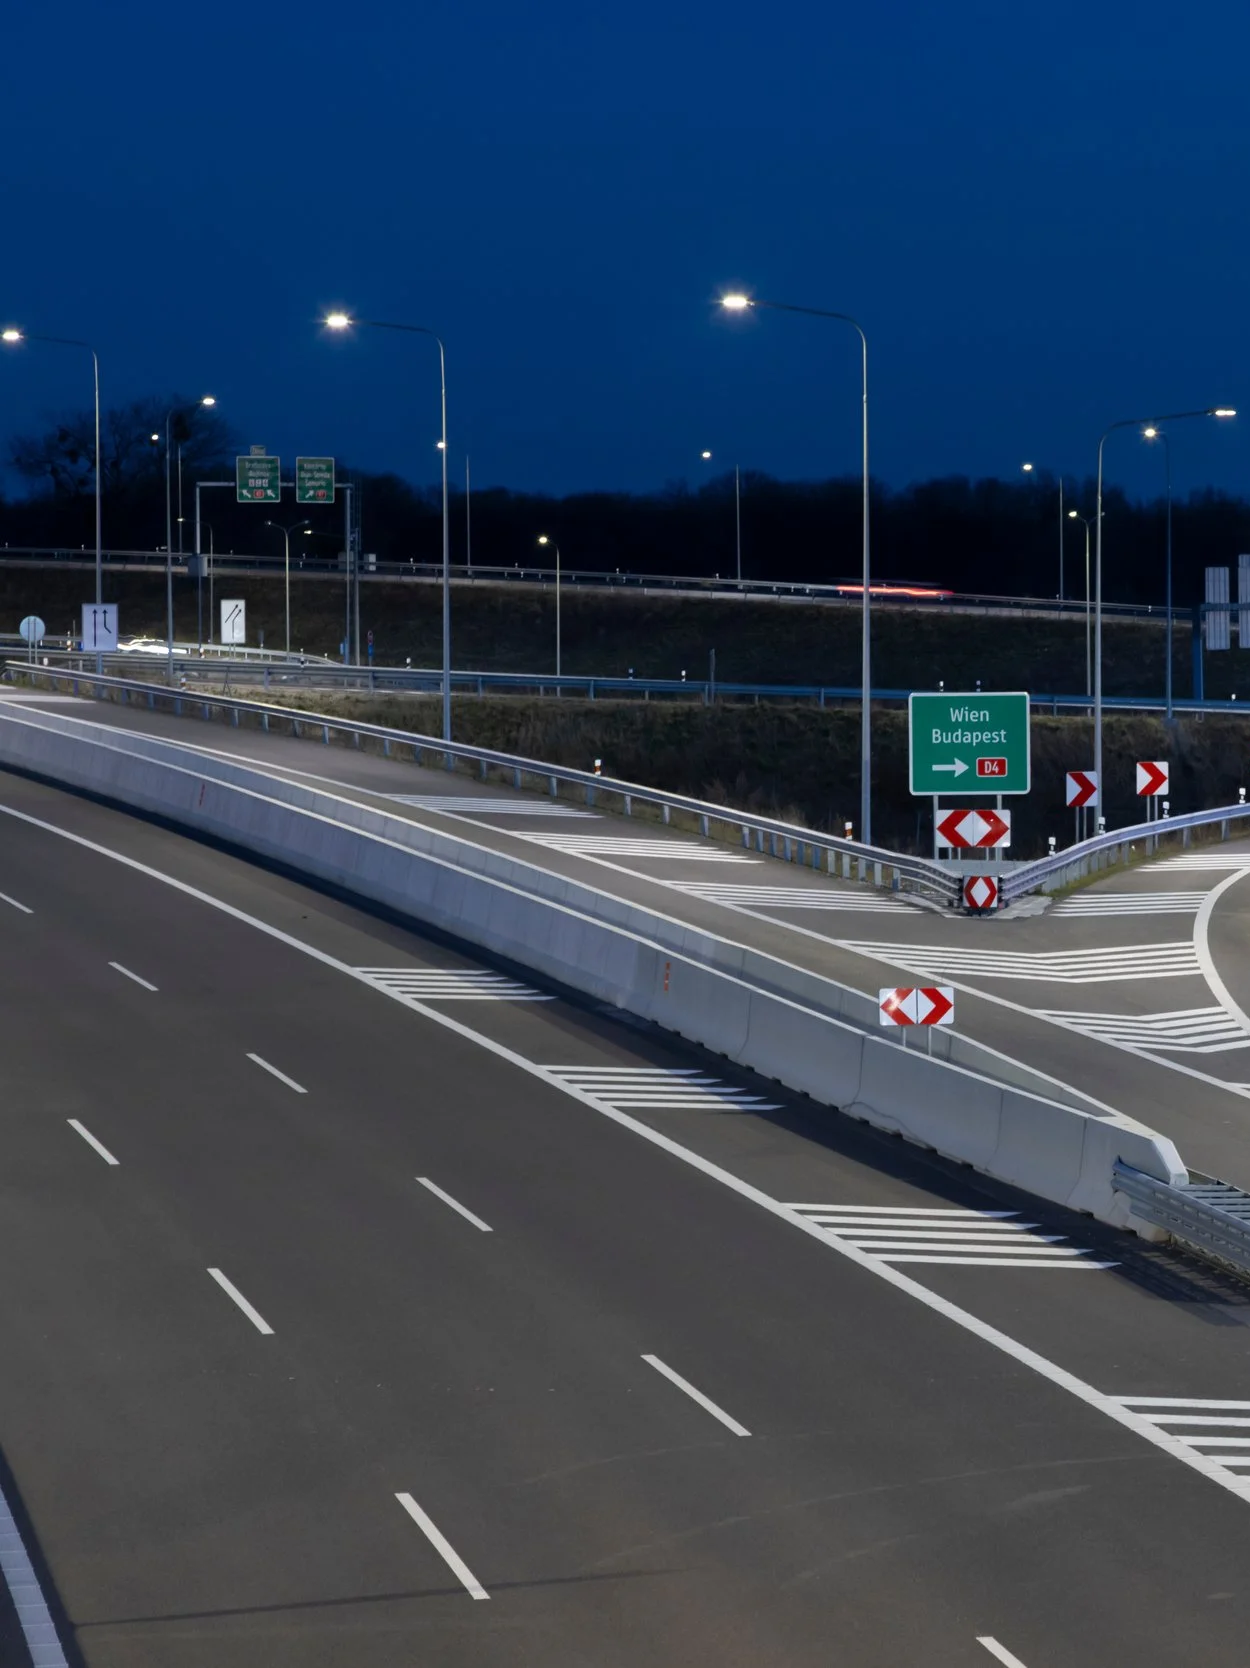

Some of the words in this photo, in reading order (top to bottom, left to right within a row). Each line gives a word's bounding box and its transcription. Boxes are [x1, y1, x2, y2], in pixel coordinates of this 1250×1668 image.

[950, 707, 990, 722] Wien
[931, 728, 1007, 747] Budapest
[984, 761, 999, 774] D4
